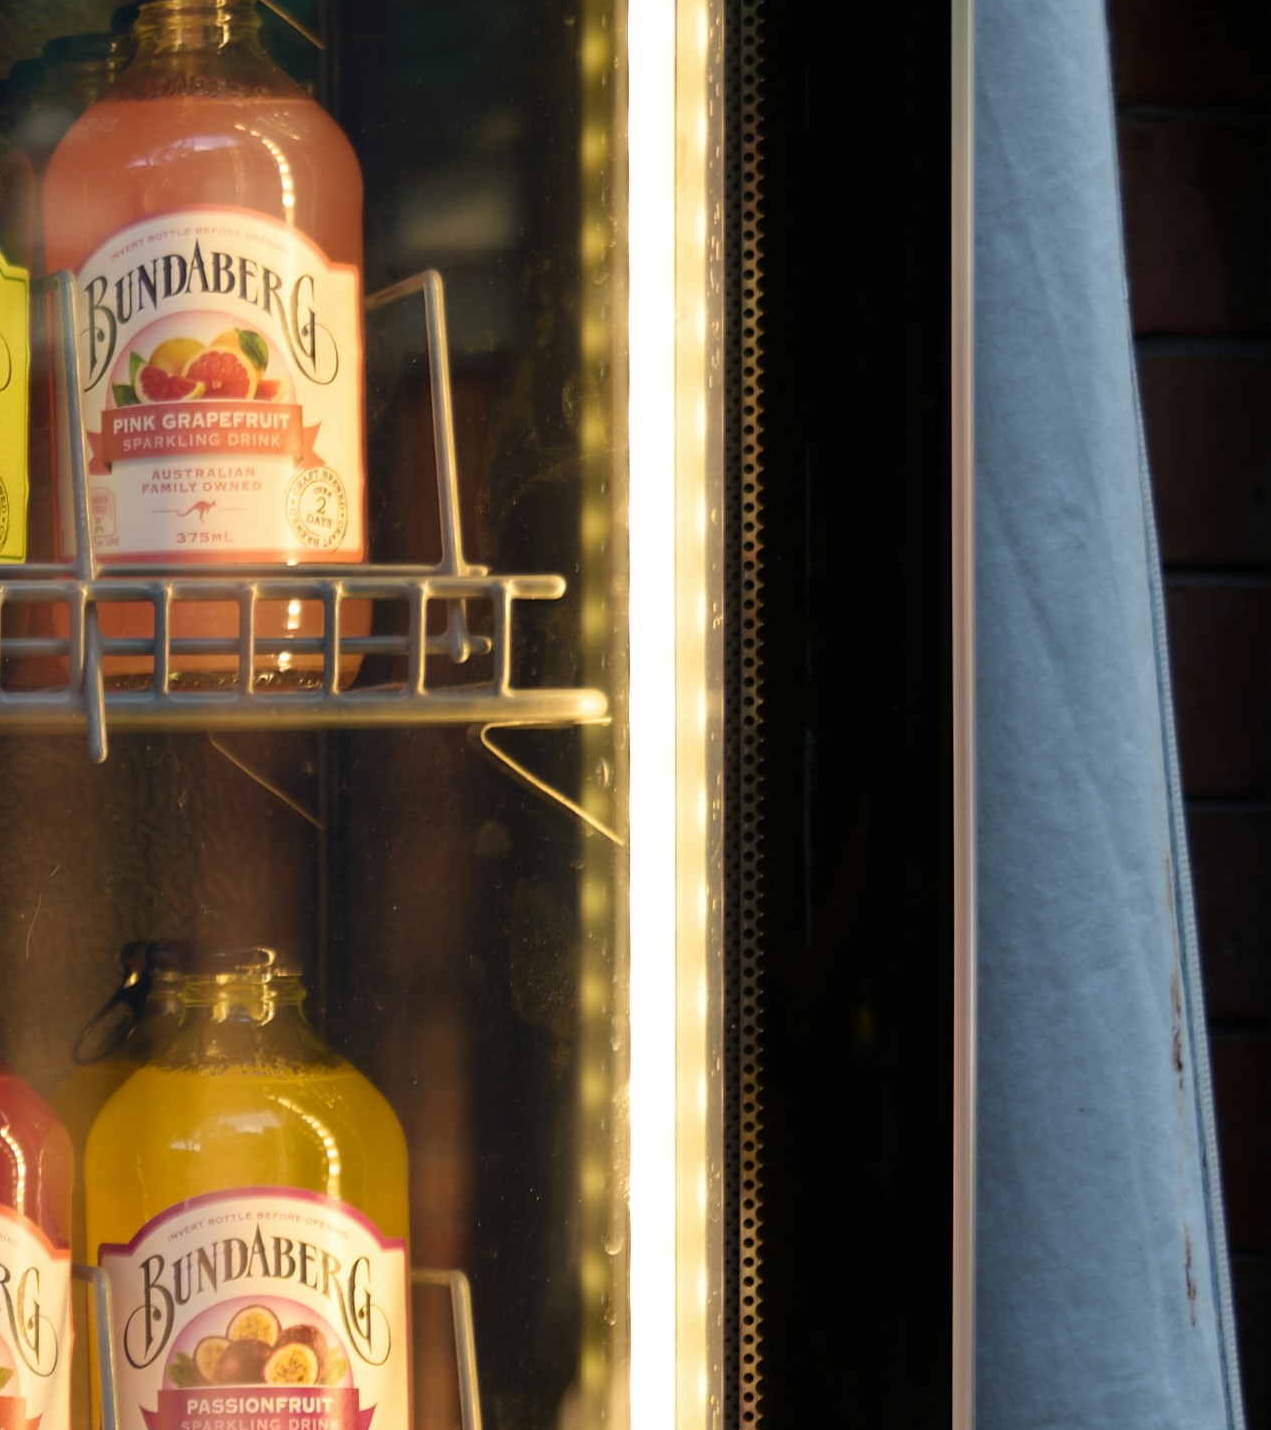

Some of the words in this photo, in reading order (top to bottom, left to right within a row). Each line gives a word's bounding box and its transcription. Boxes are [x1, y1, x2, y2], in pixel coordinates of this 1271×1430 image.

[79, 238, 340, 393] BUNDABERG
[112, 413, 156, 433] PINK
[161, 412, 292, 431] GRAPEFRUIT
[122, 433, 222, 452] SPARKLING
[227, 432, 282, 449] DRINK
[122, 1222, 393, 1371] BUNDABERG
[186, 1397, 335, 1416] PASSIONFRUIT
